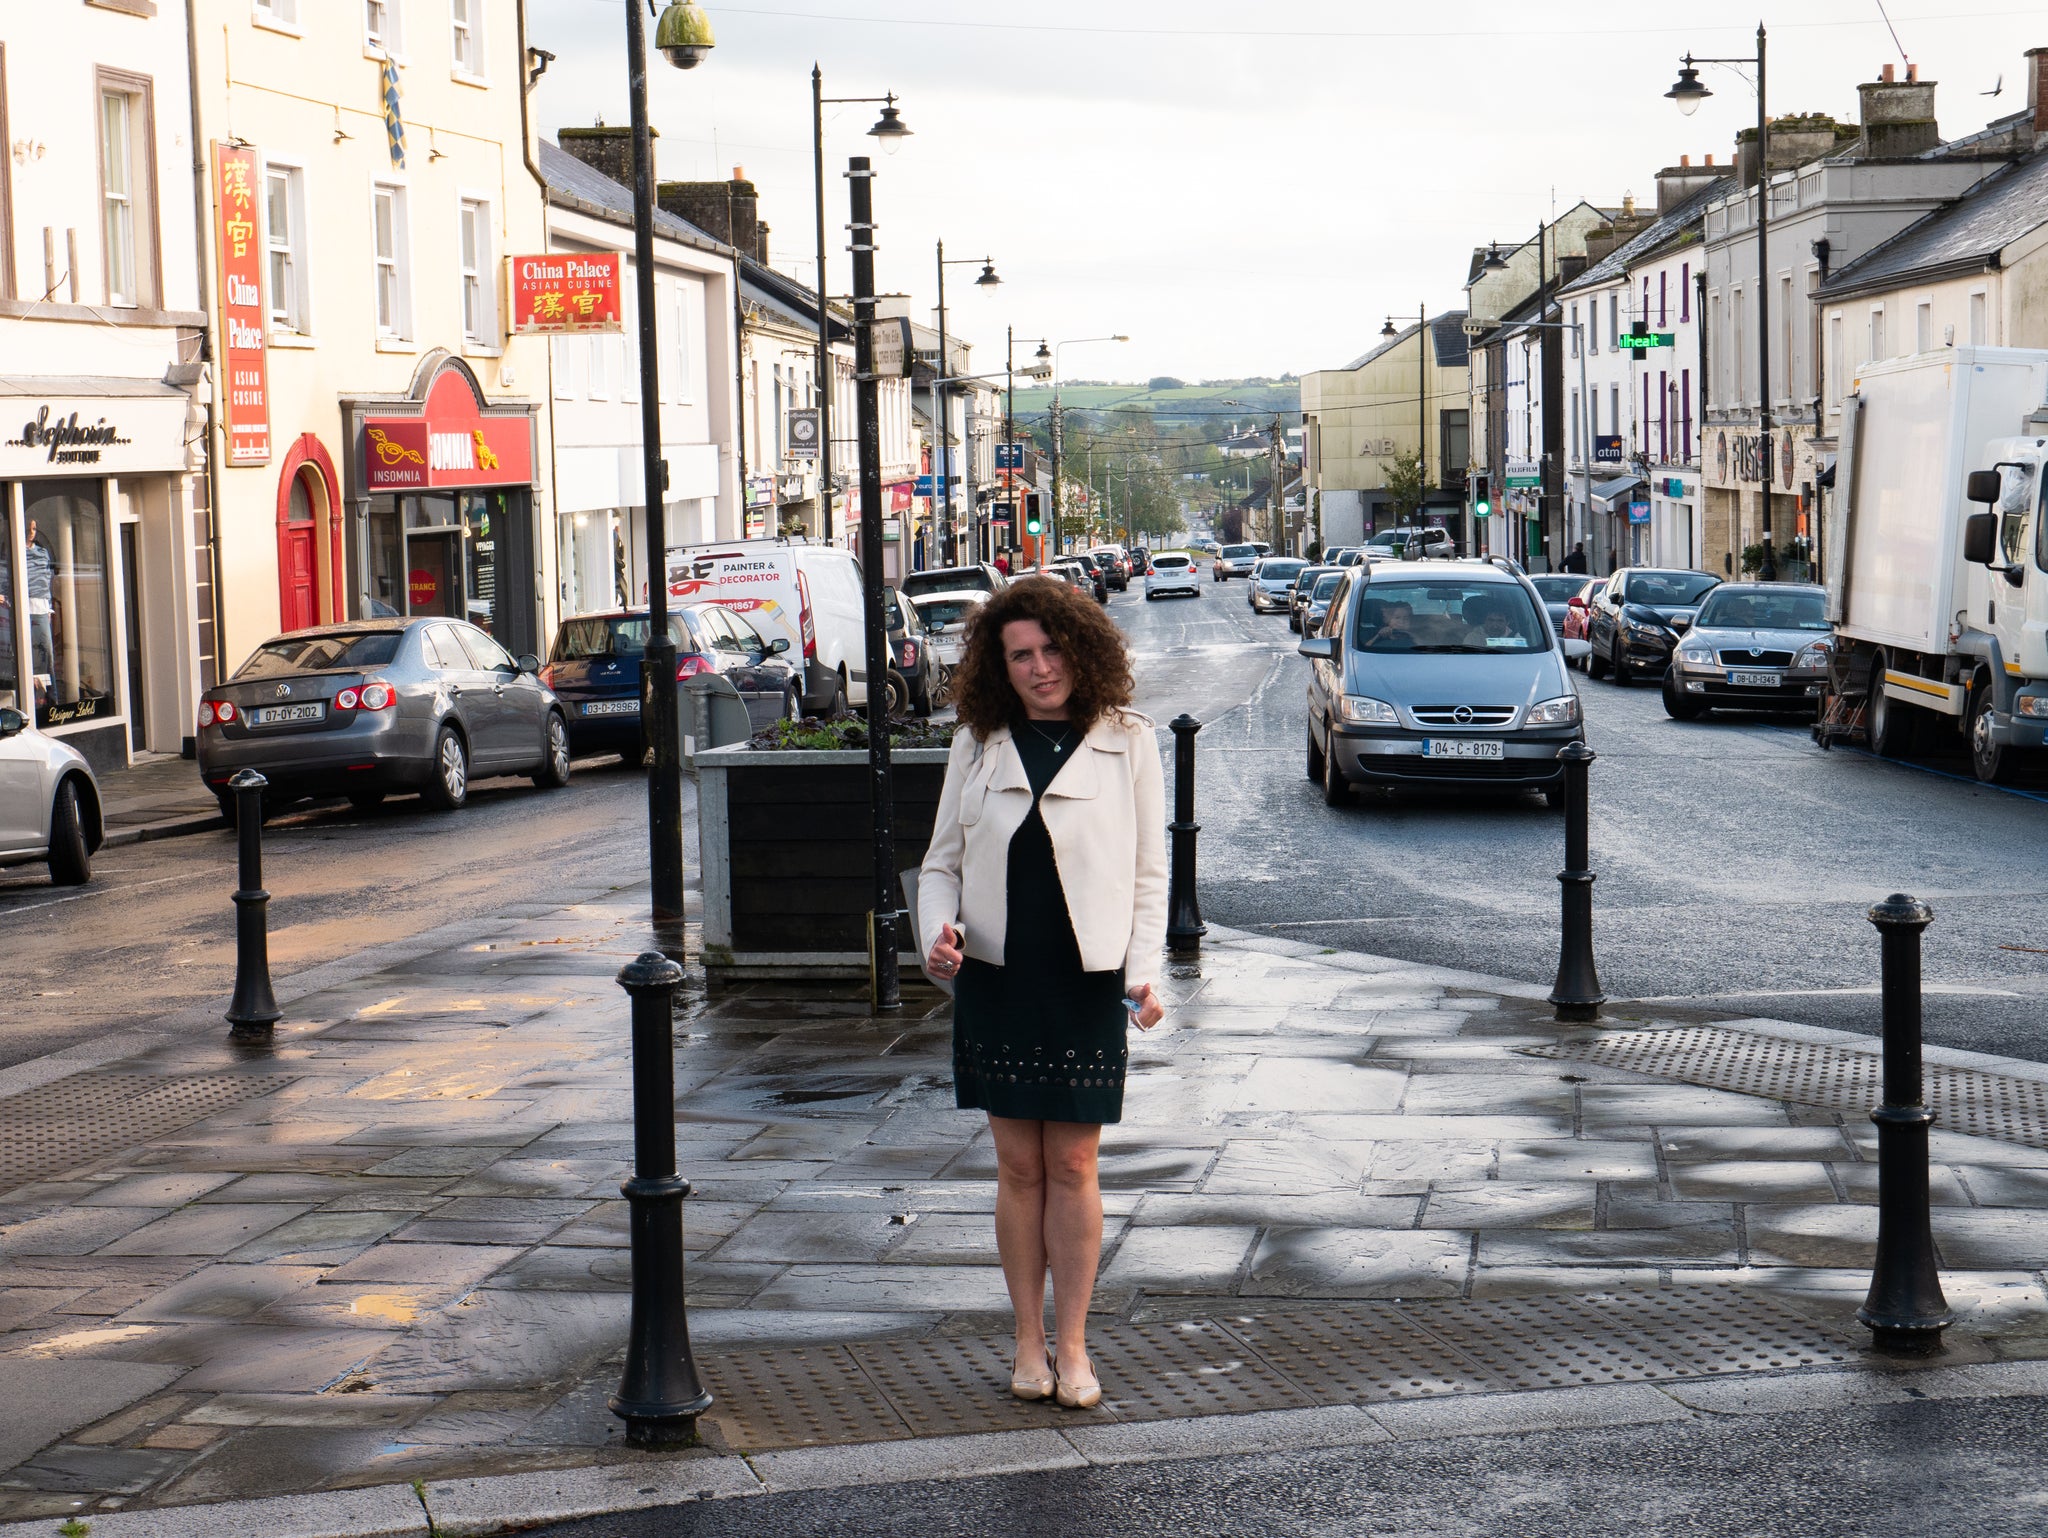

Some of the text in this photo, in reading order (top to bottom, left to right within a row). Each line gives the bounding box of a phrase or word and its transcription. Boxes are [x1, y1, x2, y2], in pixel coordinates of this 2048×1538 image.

[523, 260, 610, 279] China Palace
[227, 274, 259, 307] China
[522, 280, 612, 290] ASIAN CUSINE
[228, 317, 262, 350] Palace
[235, 370, 260, 387] ASIAN
[233, 390, 263, 406] CUSINE
[1360, 438, 1396, 456] AIB
[1597, 447, 1620, 457] atm
[57, 450, 101, 464] BOUTIQUE
[374, 470, 421, 482] INSOMNIA
[724, 563, 765, 572] PAINTER
[720, 573, 780, 584] DECORATOR
[1736, 673, 1776, 684] 08-LD-1345
[49, 706, 75, 724] Designer
